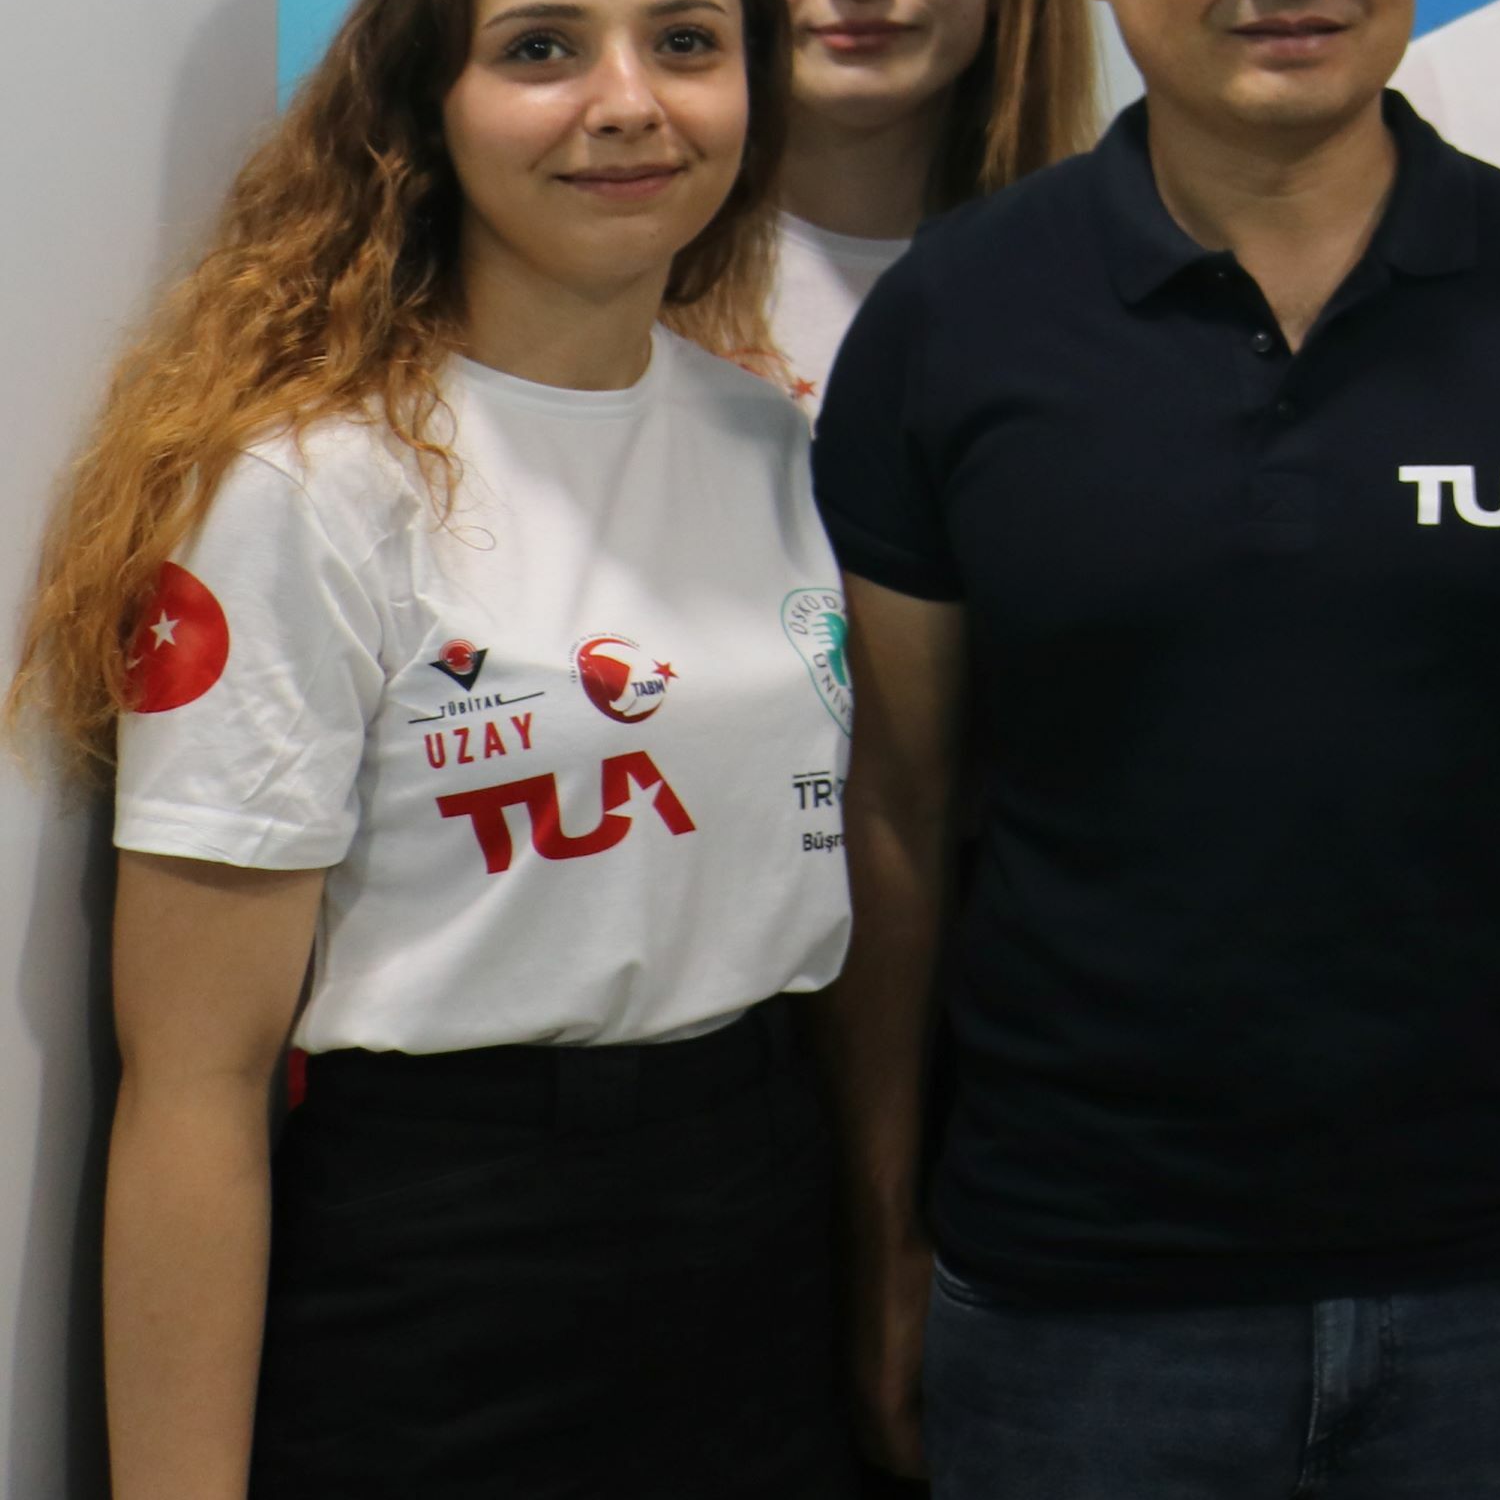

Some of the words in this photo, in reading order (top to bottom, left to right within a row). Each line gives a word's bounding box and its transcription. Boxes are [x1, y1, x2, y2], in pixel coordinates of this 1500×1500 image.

[440, 692, 504, 718] TÜBİTAK
[631, 680, 666, 698] TABM
[424, 712, 533, 770] UZAY
[435, 750, 697, 875] TUA
